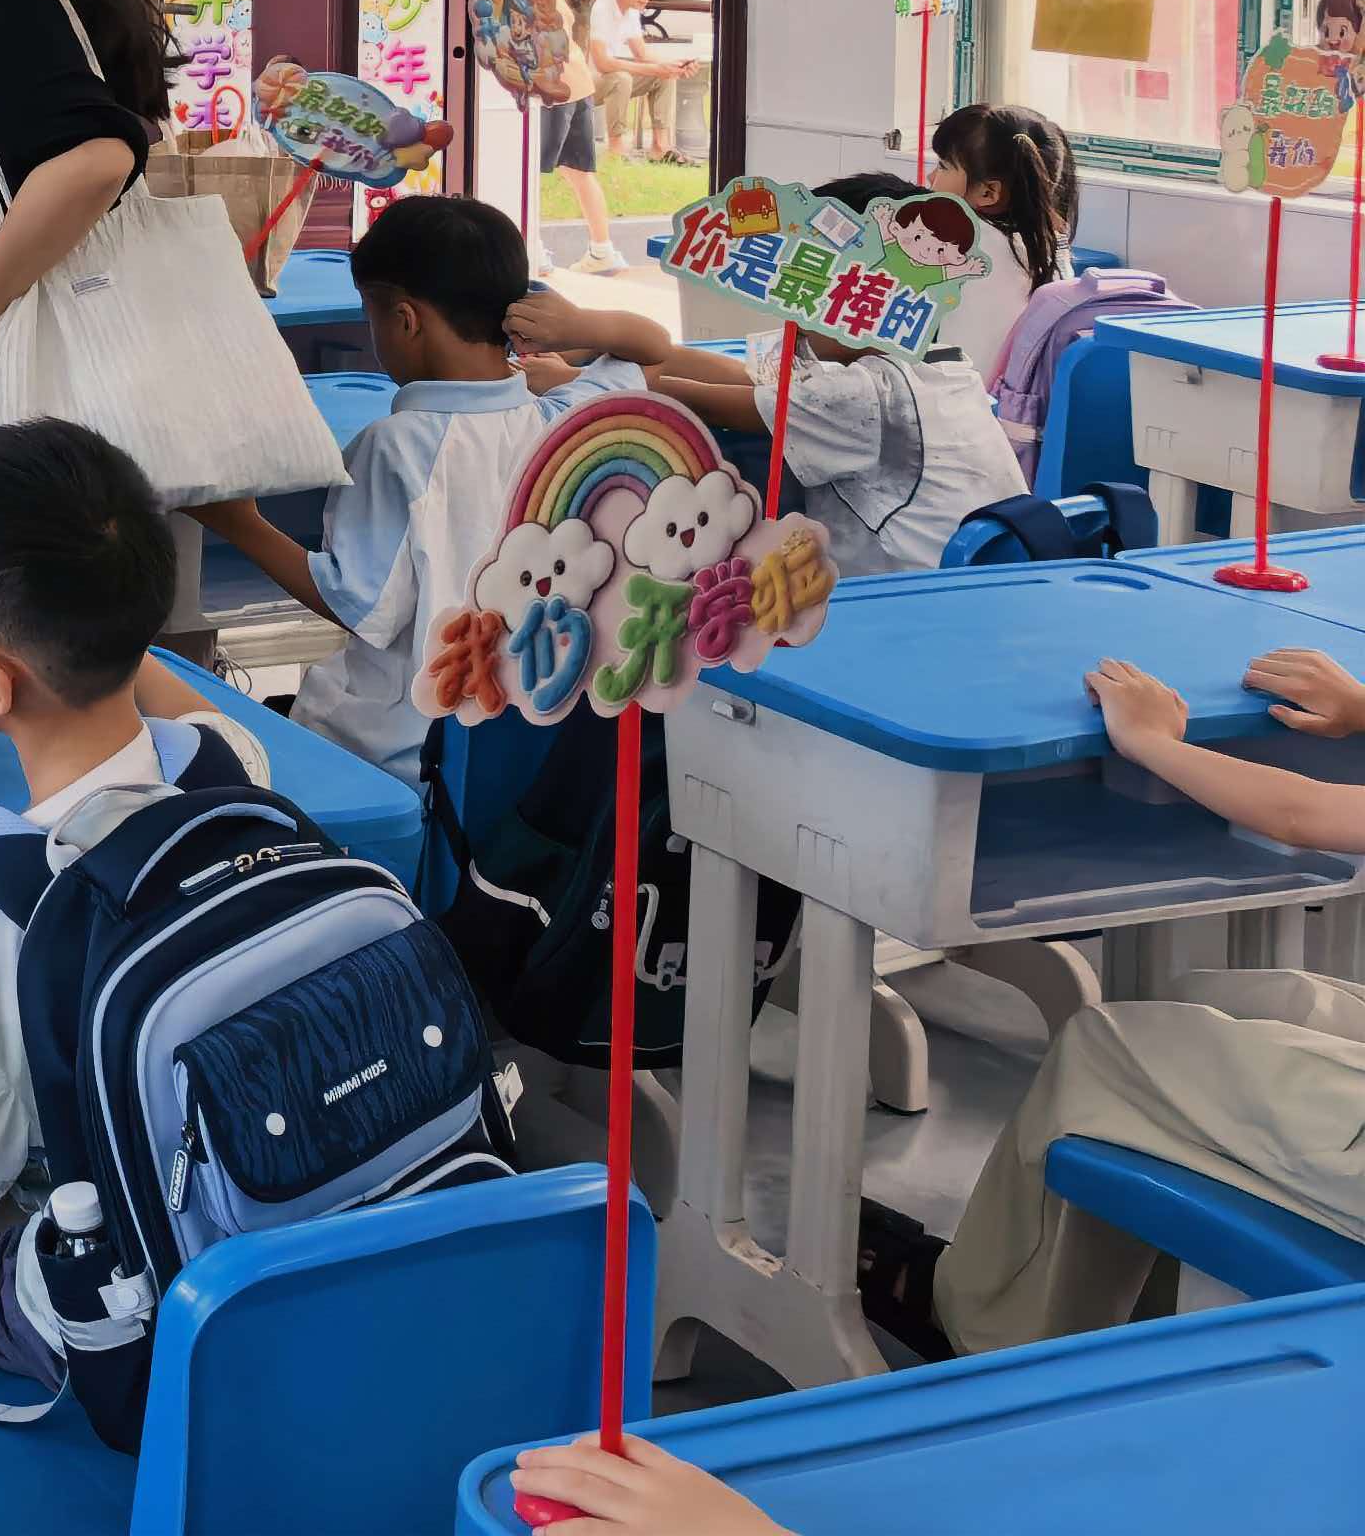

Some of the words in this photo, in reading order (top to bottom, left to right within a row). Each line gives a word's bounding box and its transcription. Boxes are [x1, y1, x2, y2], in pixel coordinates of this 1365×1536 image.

[670, 206, 933, 351] 你是最棒的
